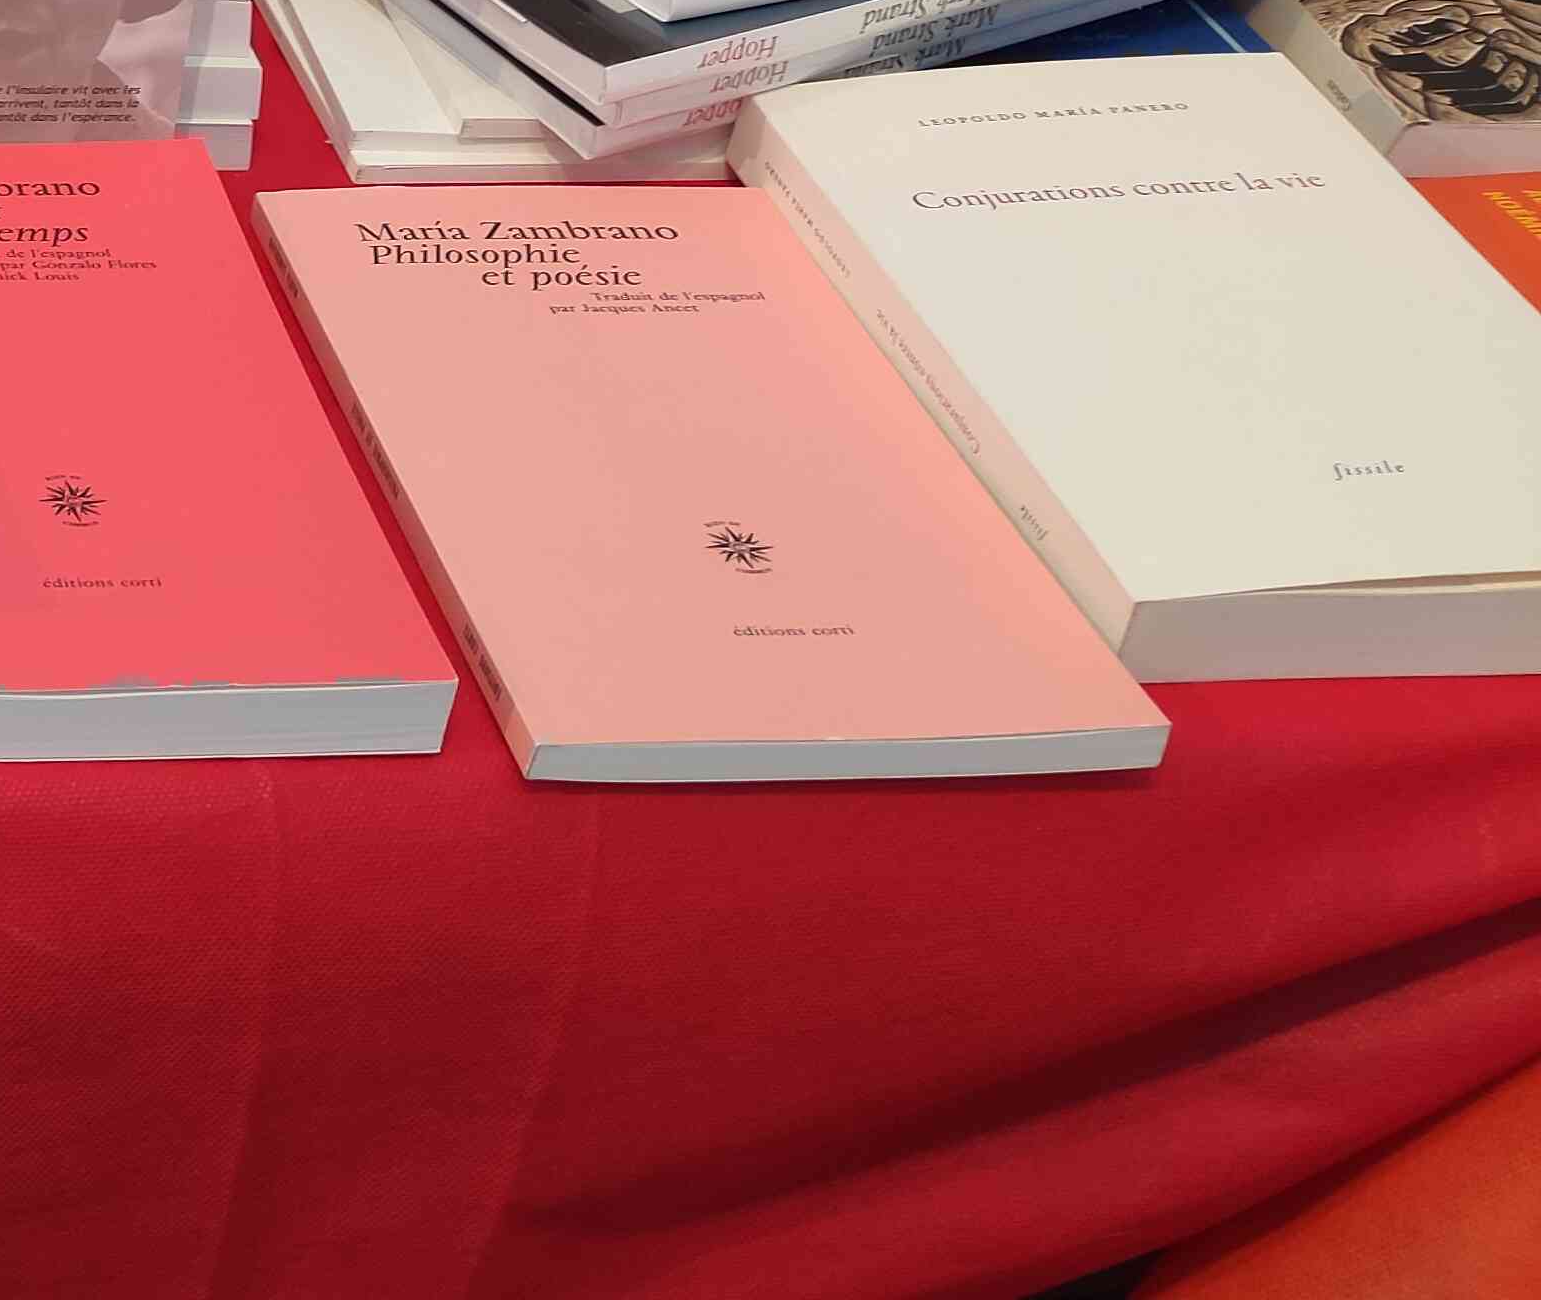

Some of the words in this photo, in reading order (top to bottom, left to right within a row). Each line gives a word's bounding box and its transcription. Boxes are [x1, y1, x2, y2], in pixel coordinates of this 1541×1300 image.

[698, 36, 778, 68] Hopper
[912, 180, 1125, 212] Conjurations
[1133, 177, 1233, 196] contre
[1237, 172, 1271, 192] la
[1276, 171, 1325, 190] vie
[354, 221, 471, 241] María
[480, 221, 679, 240] Zambrano
[7, 249, 26, 257] de
[30, 249, 111, 260] l'espagnol
[369, 245, 581, 268] Philosophie
[0, 262, 25, 270] par
[32, 261, 100, 269] Gonzalo
[107, 261, 157, 269] Flores
[34, 272, 80, 281] Louis
[481, 268, 515, 286] et
[531, 265, 643, 290] poésie
[591, 292, 654, 301] Traduit
[658, 292, 680, 301] de
[684, 292, 765, 303] l'espagnol
[549, 306, 576, 315] par
[581, 304, 645, 315] Jacques
[650, 303, 699, 313] Ancet
[43, 576, 115, 588] éditions
[120, 578, 162, 588] corti
[733, 625, 805, 637] éditions
